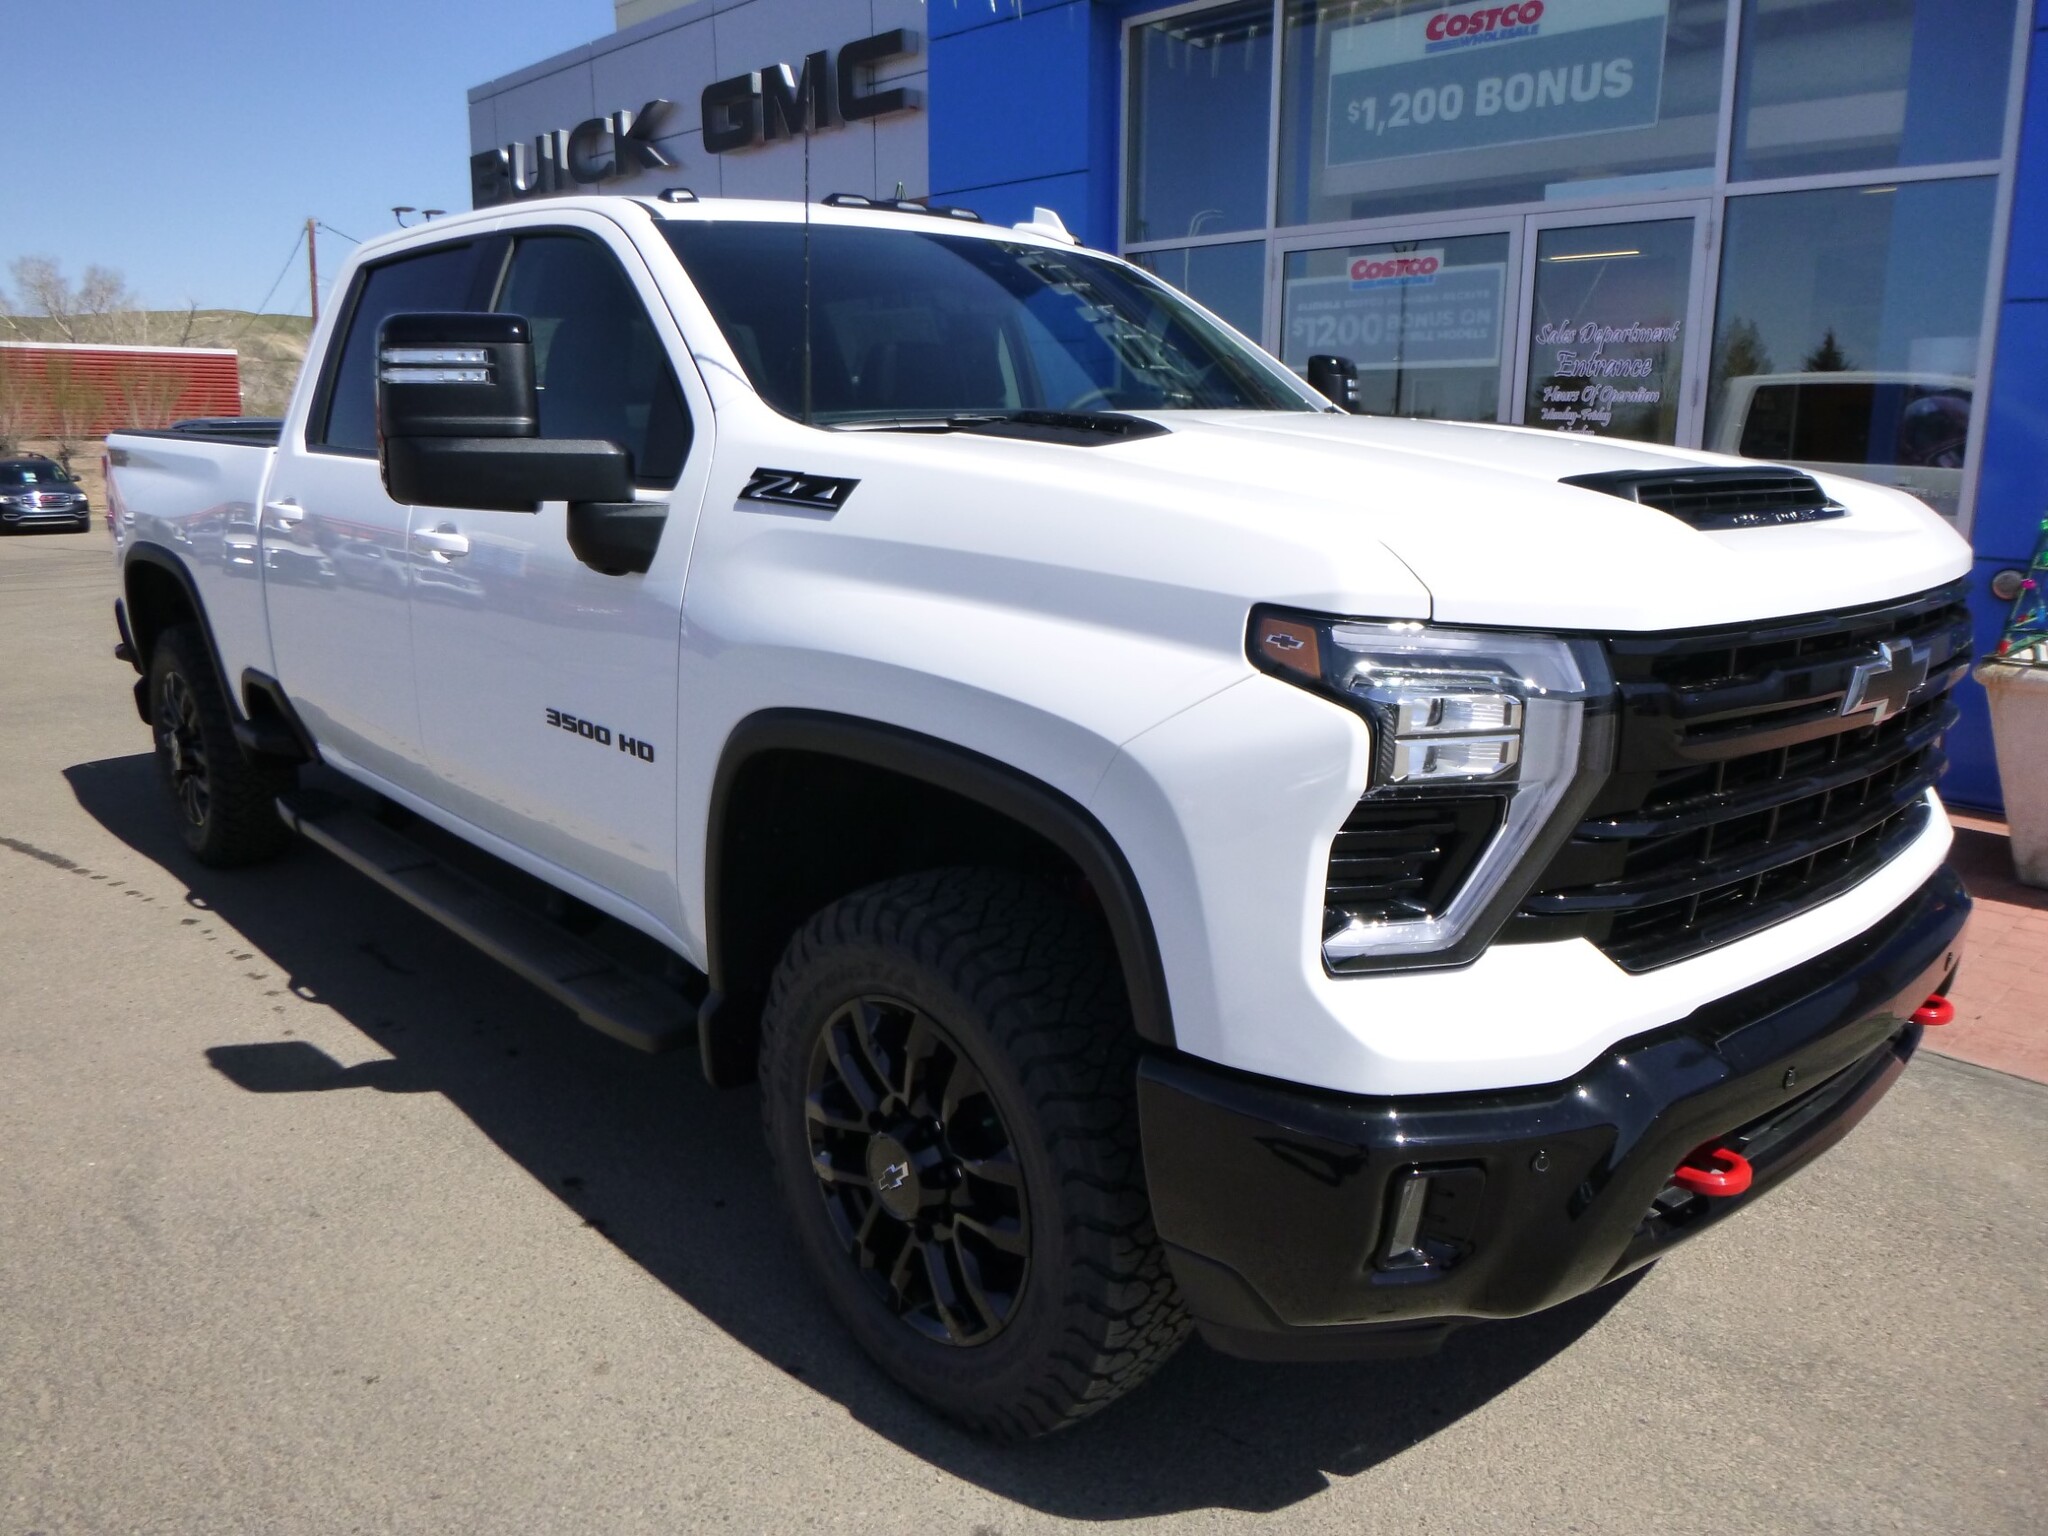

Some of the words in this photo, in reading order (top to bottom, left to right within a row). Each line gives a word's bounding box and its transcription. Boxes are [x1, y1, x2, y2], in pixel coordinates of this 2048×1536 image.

[1425, 0, 1545, 41] COSTCO
[1347, 83, 1464, 136] $1,200
[1475, 57, 1635, 118] BONUS
[470, 99, 676, 209] BUICK
[701, 28, 921, 154] GMC
[1351, 257, 1438, 280] COSTCO
[1460, 308, 1491, 325] ON
[1536, 320, 1576, 345] Sales
[1579, 321, 1680, 354] Department
[1554, 350, 1653, 378] Entrance
[546, 708, 611, 746] 3500
[619, 734, 654, 764] HD
